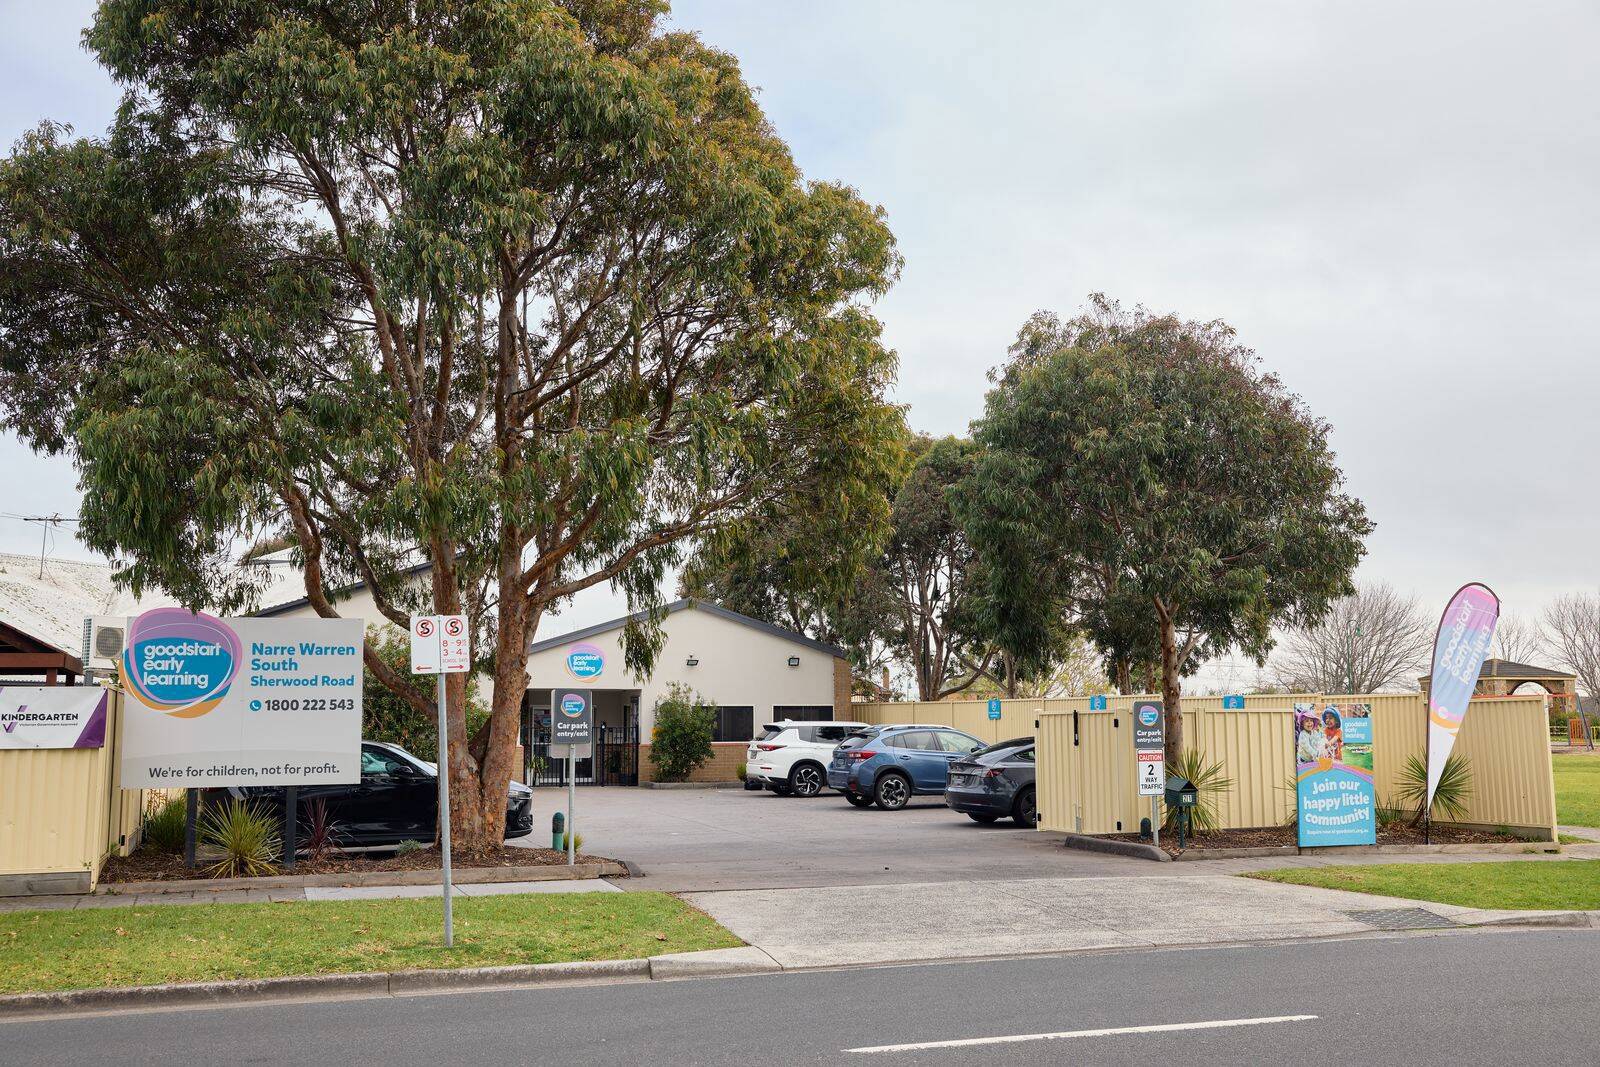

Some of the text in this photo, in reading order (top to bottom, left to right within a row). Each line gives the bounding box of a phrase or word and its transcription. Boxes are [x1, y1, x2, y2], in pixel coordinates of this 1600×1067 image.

[1440, 600, 1473, 670] goodstart
[143, 642, 221, 659] goodstart
[252, 642, 355, 656] Narre Warren
[1459, 624, 1490, 685] learning
[143, 657, 184, 673] early
[251, 658, 298, 671] South
[1450, 640, 1472, 677] early
[143, 671, 209, 689] learning
[250, 675, 355, 686] Sherwood Road
[265, 699, 354, 711] 1800 222 543
[1, 713, 79, 721] KINDERGARTEN
[571, 722, 588, 731] park
[1147, 729, 1162, 737] park
[149, 763, 340, 778] We're for children, not for profit.
[1147, 764, 1154, 776] 2
[1312, 778, 1361, 795] Join our
[1303, 791, 1370, 812] happy little
[1304, 806, 1370, 826] community
